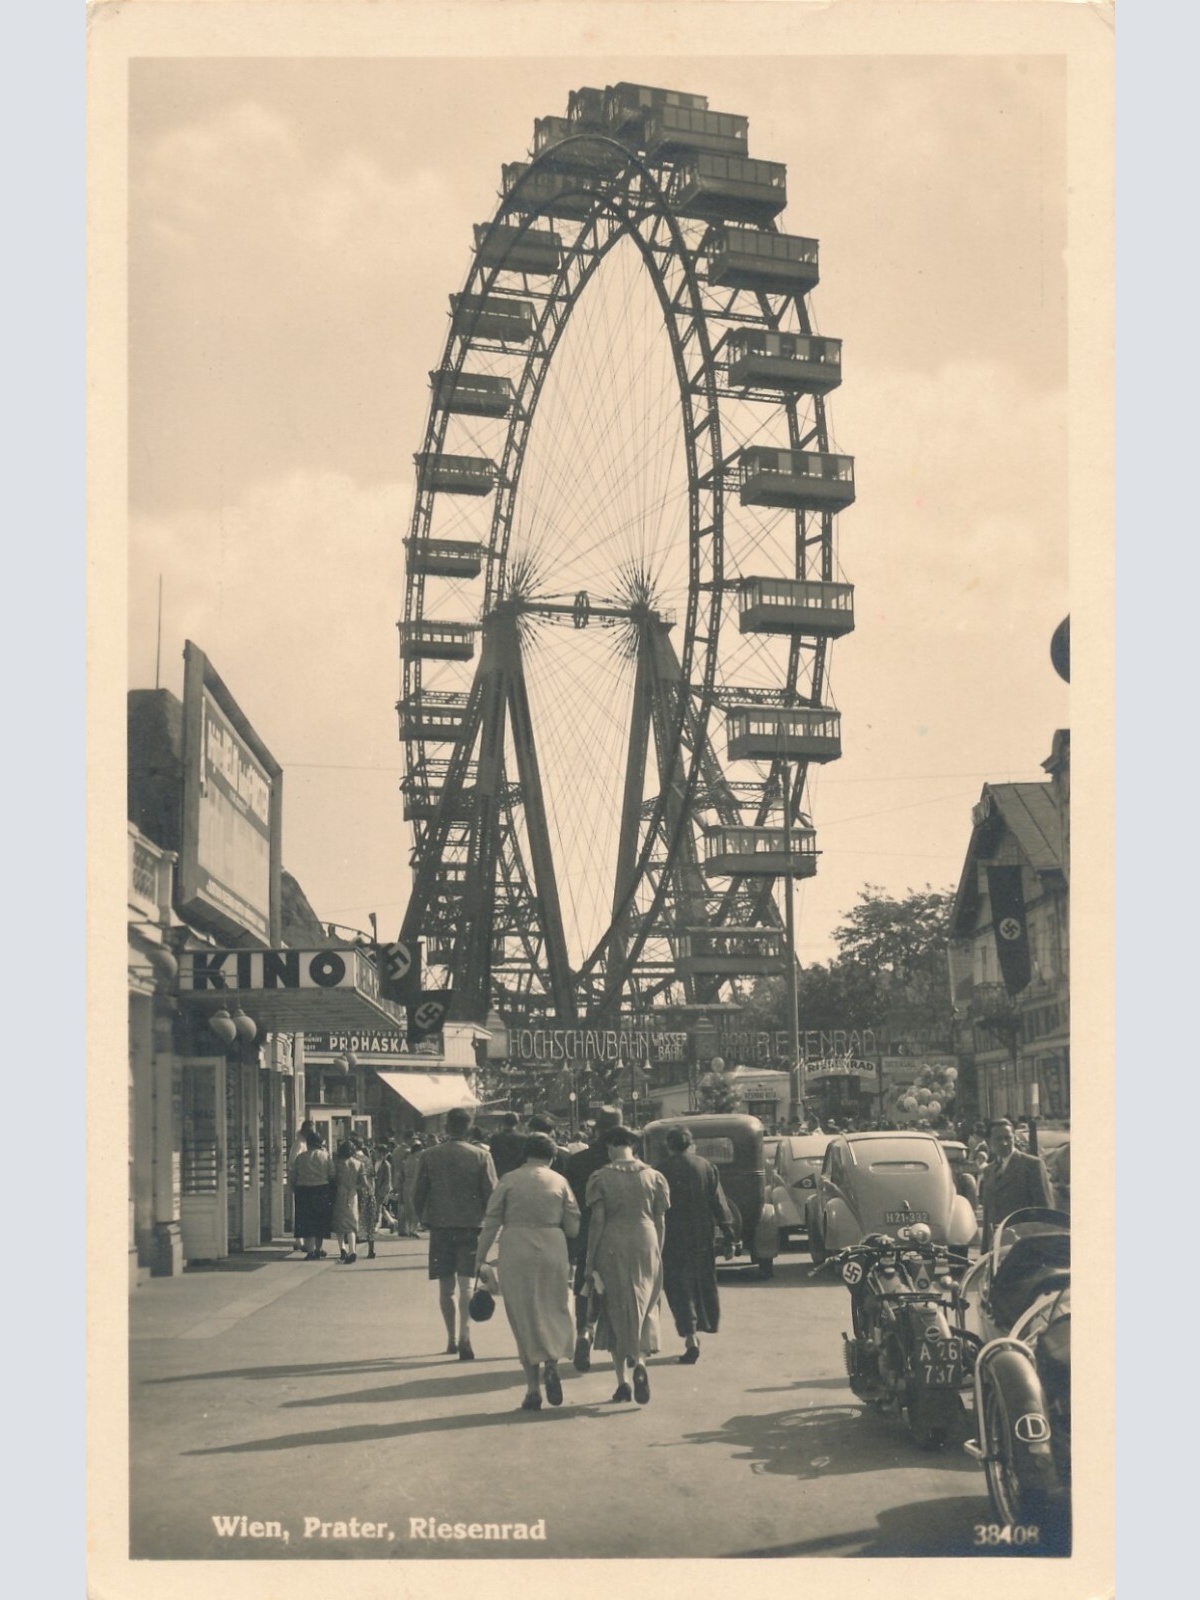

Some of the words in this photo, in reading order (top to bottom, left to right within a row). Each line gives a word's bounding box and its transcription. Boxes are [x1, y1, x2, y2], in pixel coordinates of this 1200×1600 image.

[193, 951, 346, 988] KINO
[329, 1036, 409, 1053] PROHASKA
[651, 1032, 688, 1047] WASSER
[756, 1030, 877, 1060] RIEENRAD
[920, 1343, 931, 1361] A
[924, 1365, 955, 1384] 737
[1025, 1416, 1046, 1438] D
